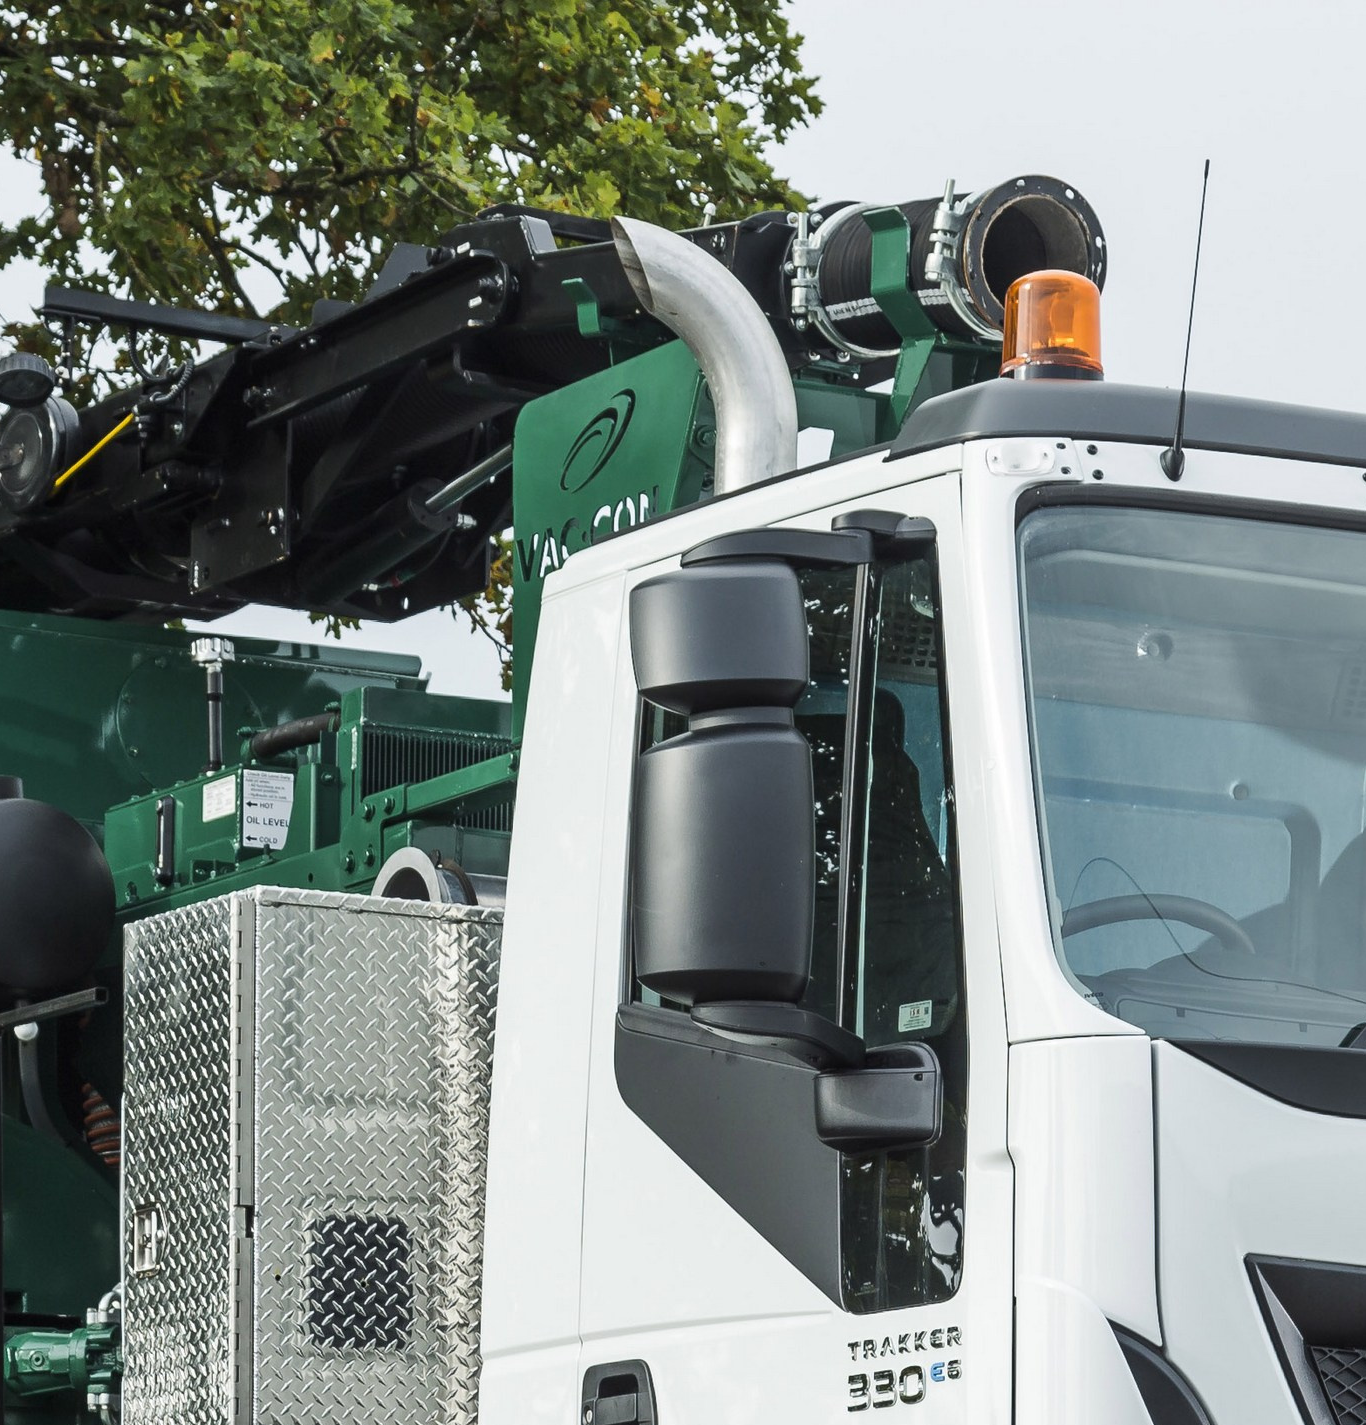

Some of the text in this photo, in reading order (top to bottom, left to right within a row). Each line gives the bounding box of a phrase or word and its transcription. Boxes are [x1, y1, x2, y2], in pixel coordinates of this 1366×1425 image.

[246, 816, 290, 828] OIL LEVEL
[258, 836, 278, 844] COLD
[847, 1326, 962, 1361] TRAKKER
[847, 1360, 962, 1413] 330 E6
